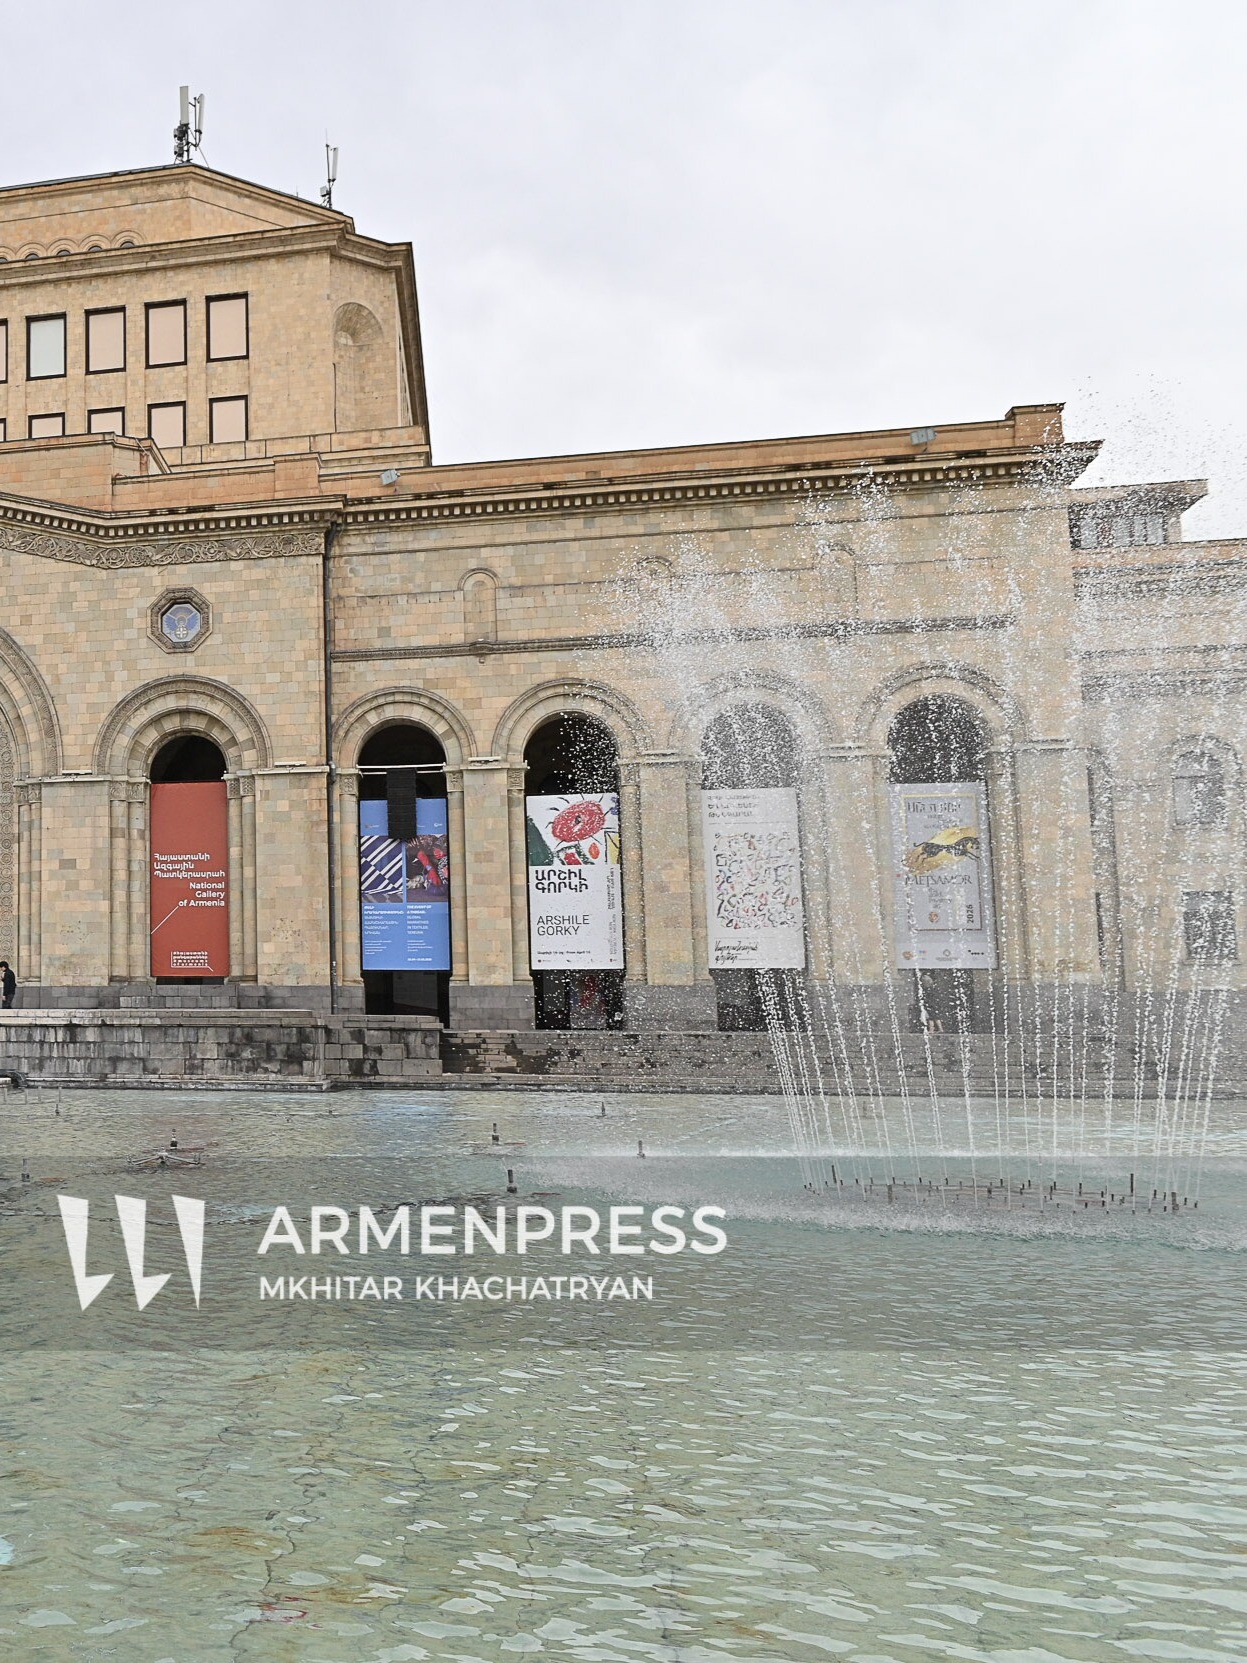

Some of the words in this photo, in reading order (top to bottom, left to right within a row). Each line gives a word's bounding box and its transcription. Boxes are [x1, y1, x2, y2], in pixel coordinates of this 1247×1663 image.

[154, 853, 210, 862] Հայաստանի
[154, 862, 194, 871] Ազգային
[154, 870, 226, 879] Պատկերասրահ
[535, 869, 587, 881] ԱՐՇԻԼ
[905, 874, 973, 887] METSAMOR
[535, 881, 589, 893] ԳՈՐԿԻ
[195, 891, 225, 899] Gallery
[178, 899, 188, 907] of
[189, 899, 225, 907] Armenia
[536, 914, 590, 925] ARSHILE
[966, 904, 974, 924] 2026
[537, 925, 580, 936] GORKY
